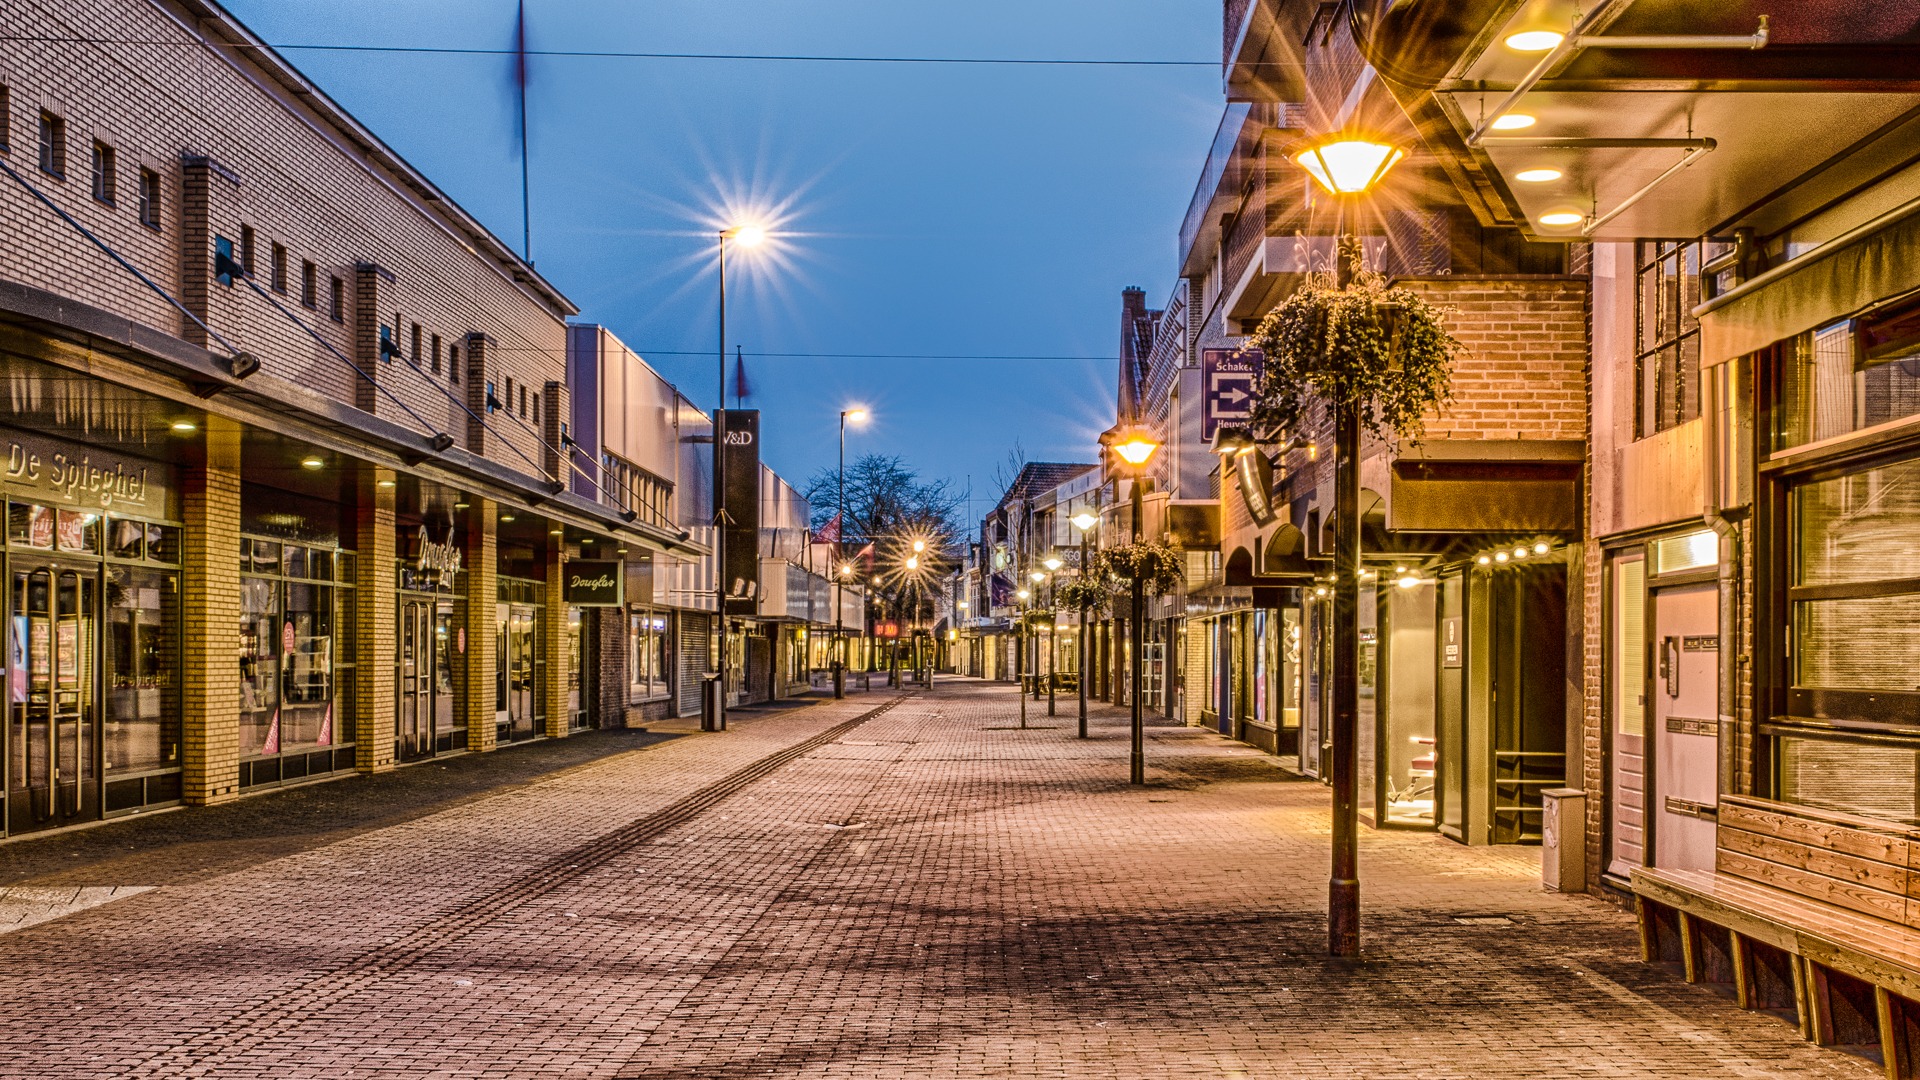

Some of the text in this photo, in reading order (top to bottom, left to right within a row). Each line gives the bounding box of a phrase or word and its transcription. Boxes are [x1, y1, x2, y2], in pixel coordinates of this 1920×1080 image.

[724, 430, 753, 445] V&D
[6, 441, 147, 506] De Spieghel
[570, 574, 615, 591] Douglas
